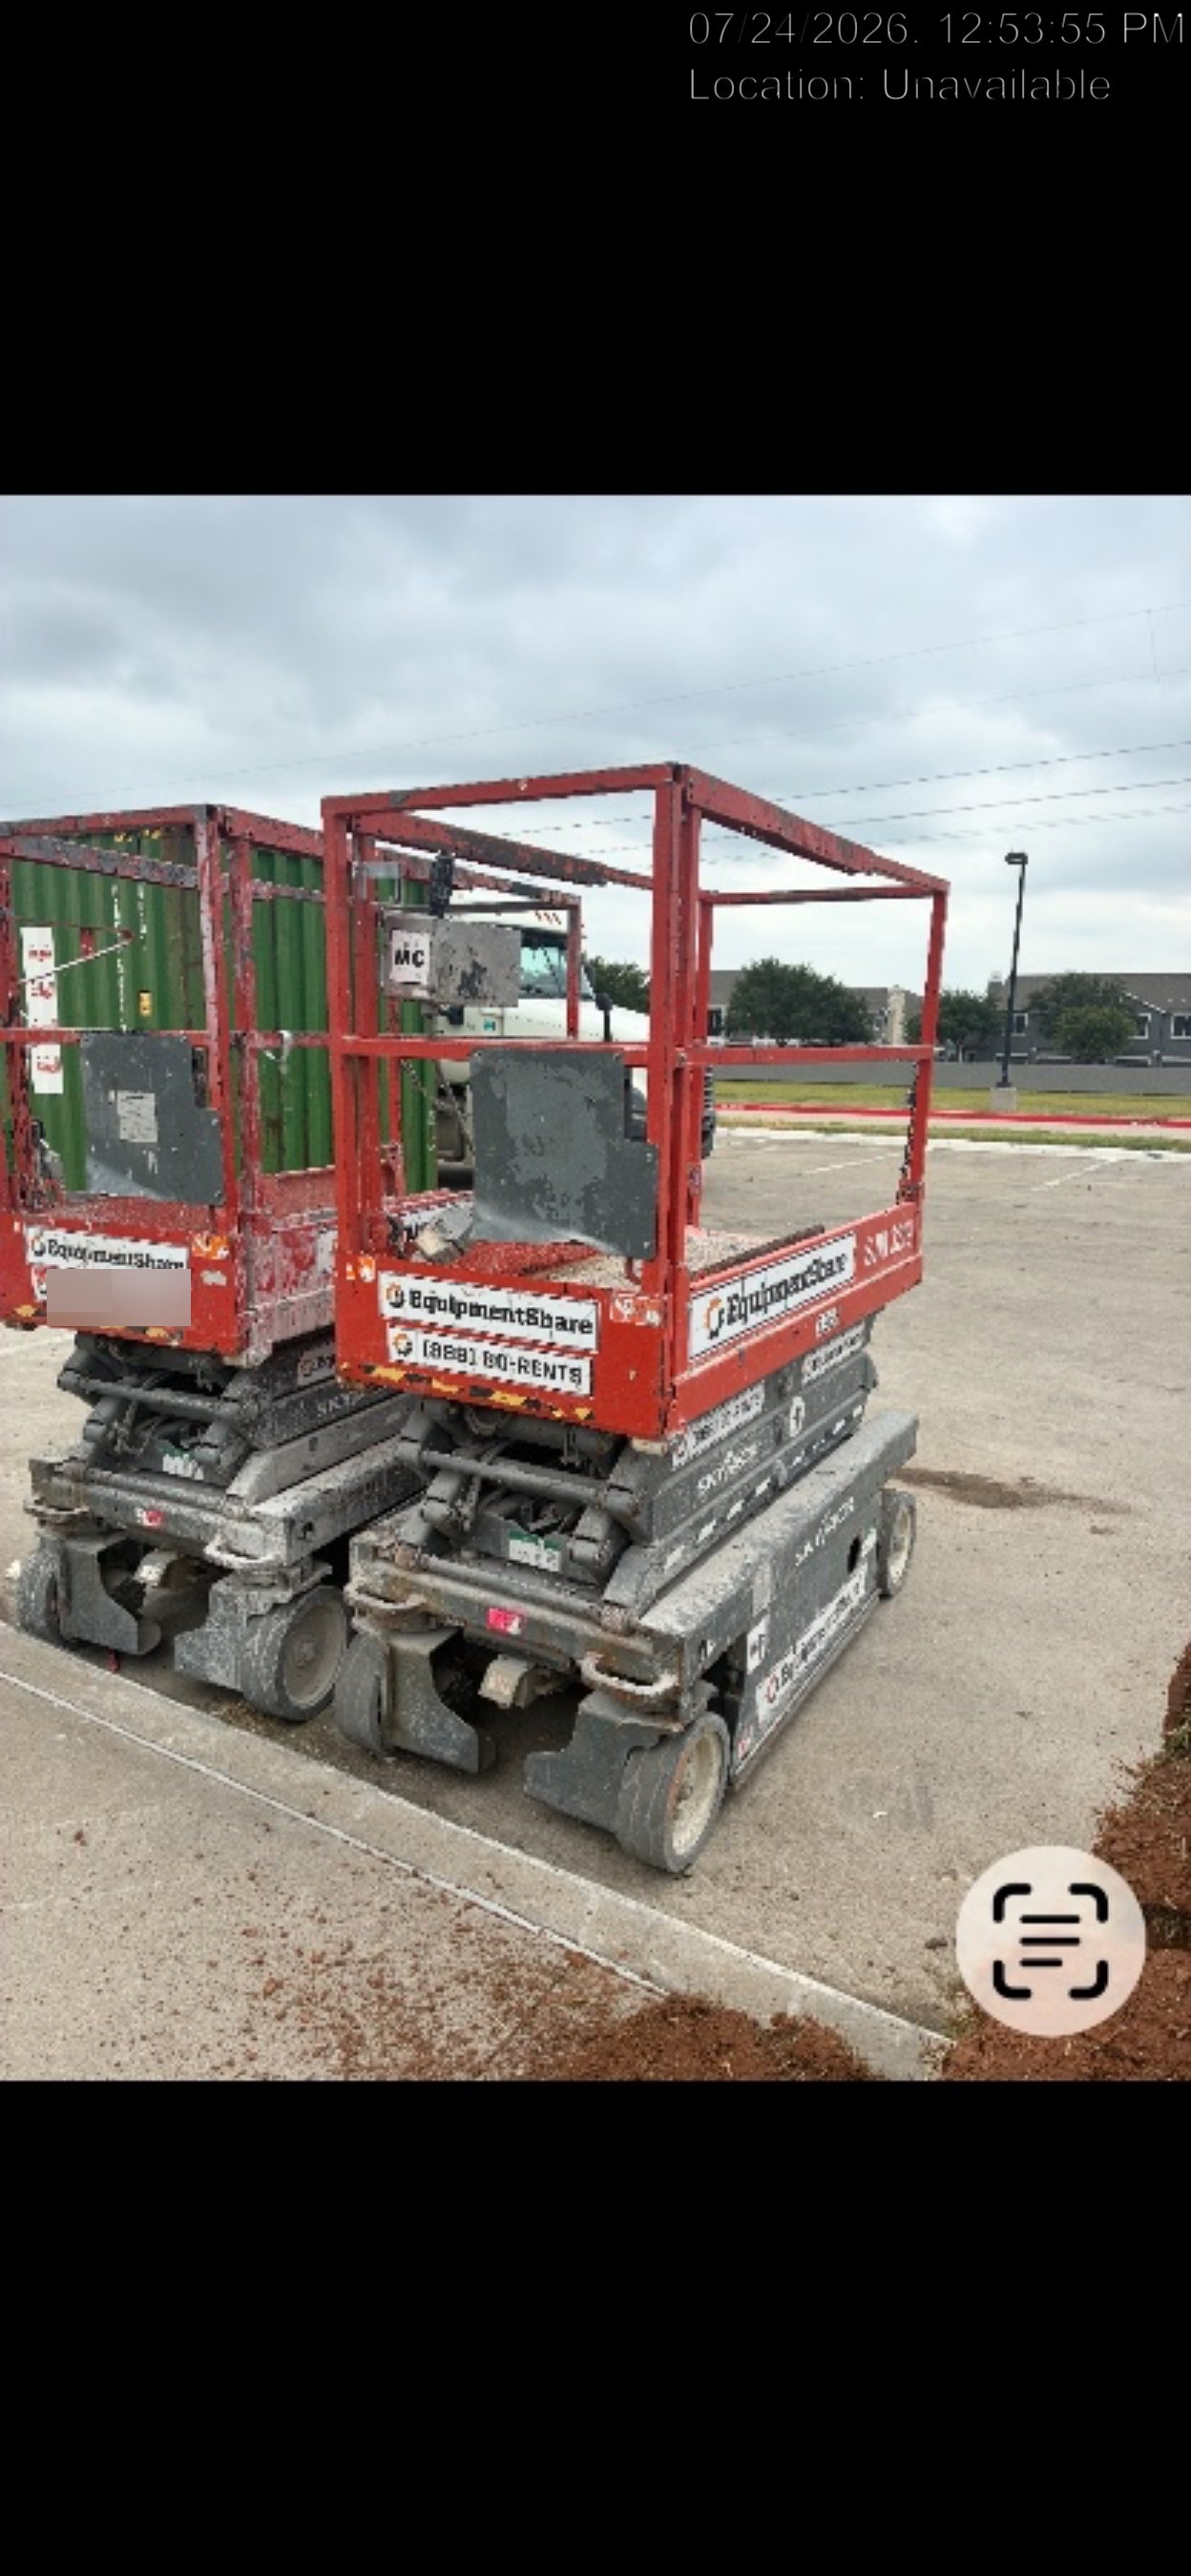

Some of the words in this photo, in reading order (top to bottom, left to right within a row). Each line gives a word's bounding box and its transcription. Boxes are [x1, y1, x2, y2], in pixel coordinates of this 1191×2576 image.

[394, 949, 425, 968] MC
[407, 1289, 594, 1335] EquipmentShare
[725, 1252, 846, 1326] EquipmentShare
